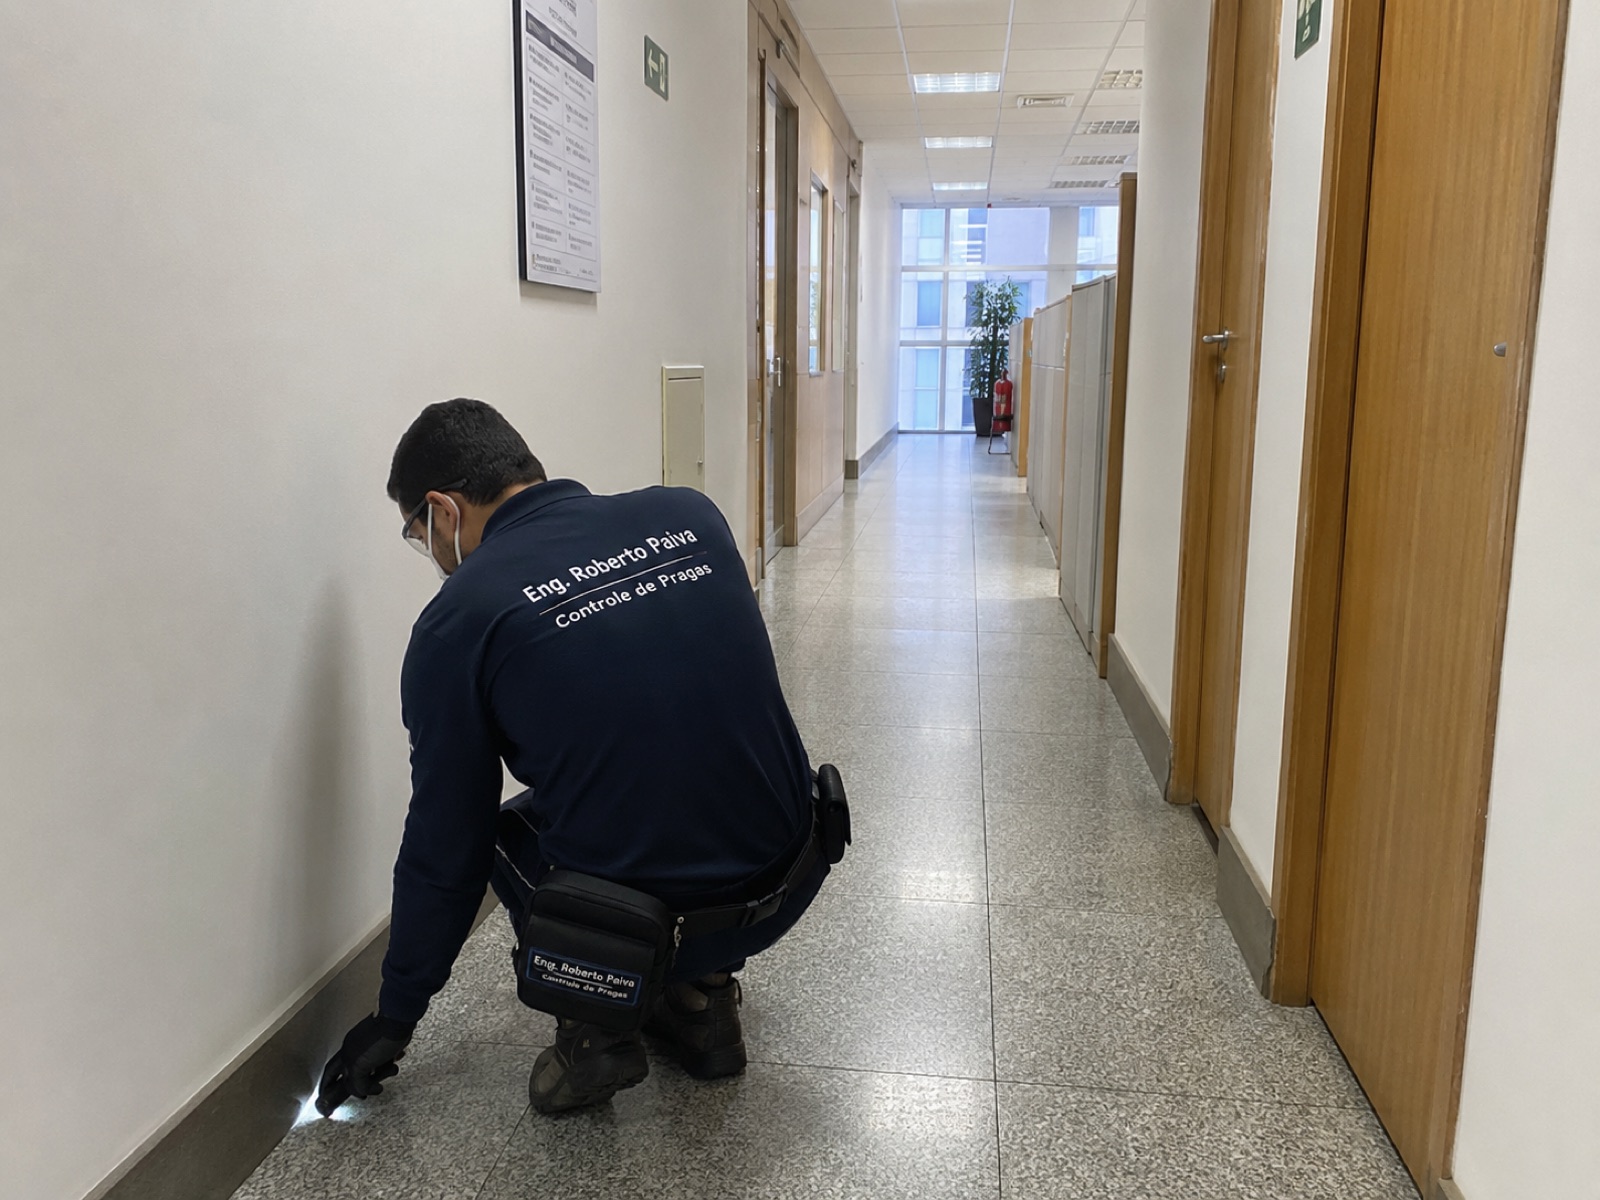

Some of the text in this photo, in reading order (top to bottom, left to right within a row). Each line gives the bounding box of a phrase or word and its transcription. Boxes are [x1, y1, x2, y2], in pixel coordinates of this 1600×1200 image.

[522, 529, 698, 603] Eng. Roberto Paiva
[555, 564, 713, 628] Controle de Pragas
[560, 962, 604, 981] Roberto
[606, 974, 635, 988] Paiva
